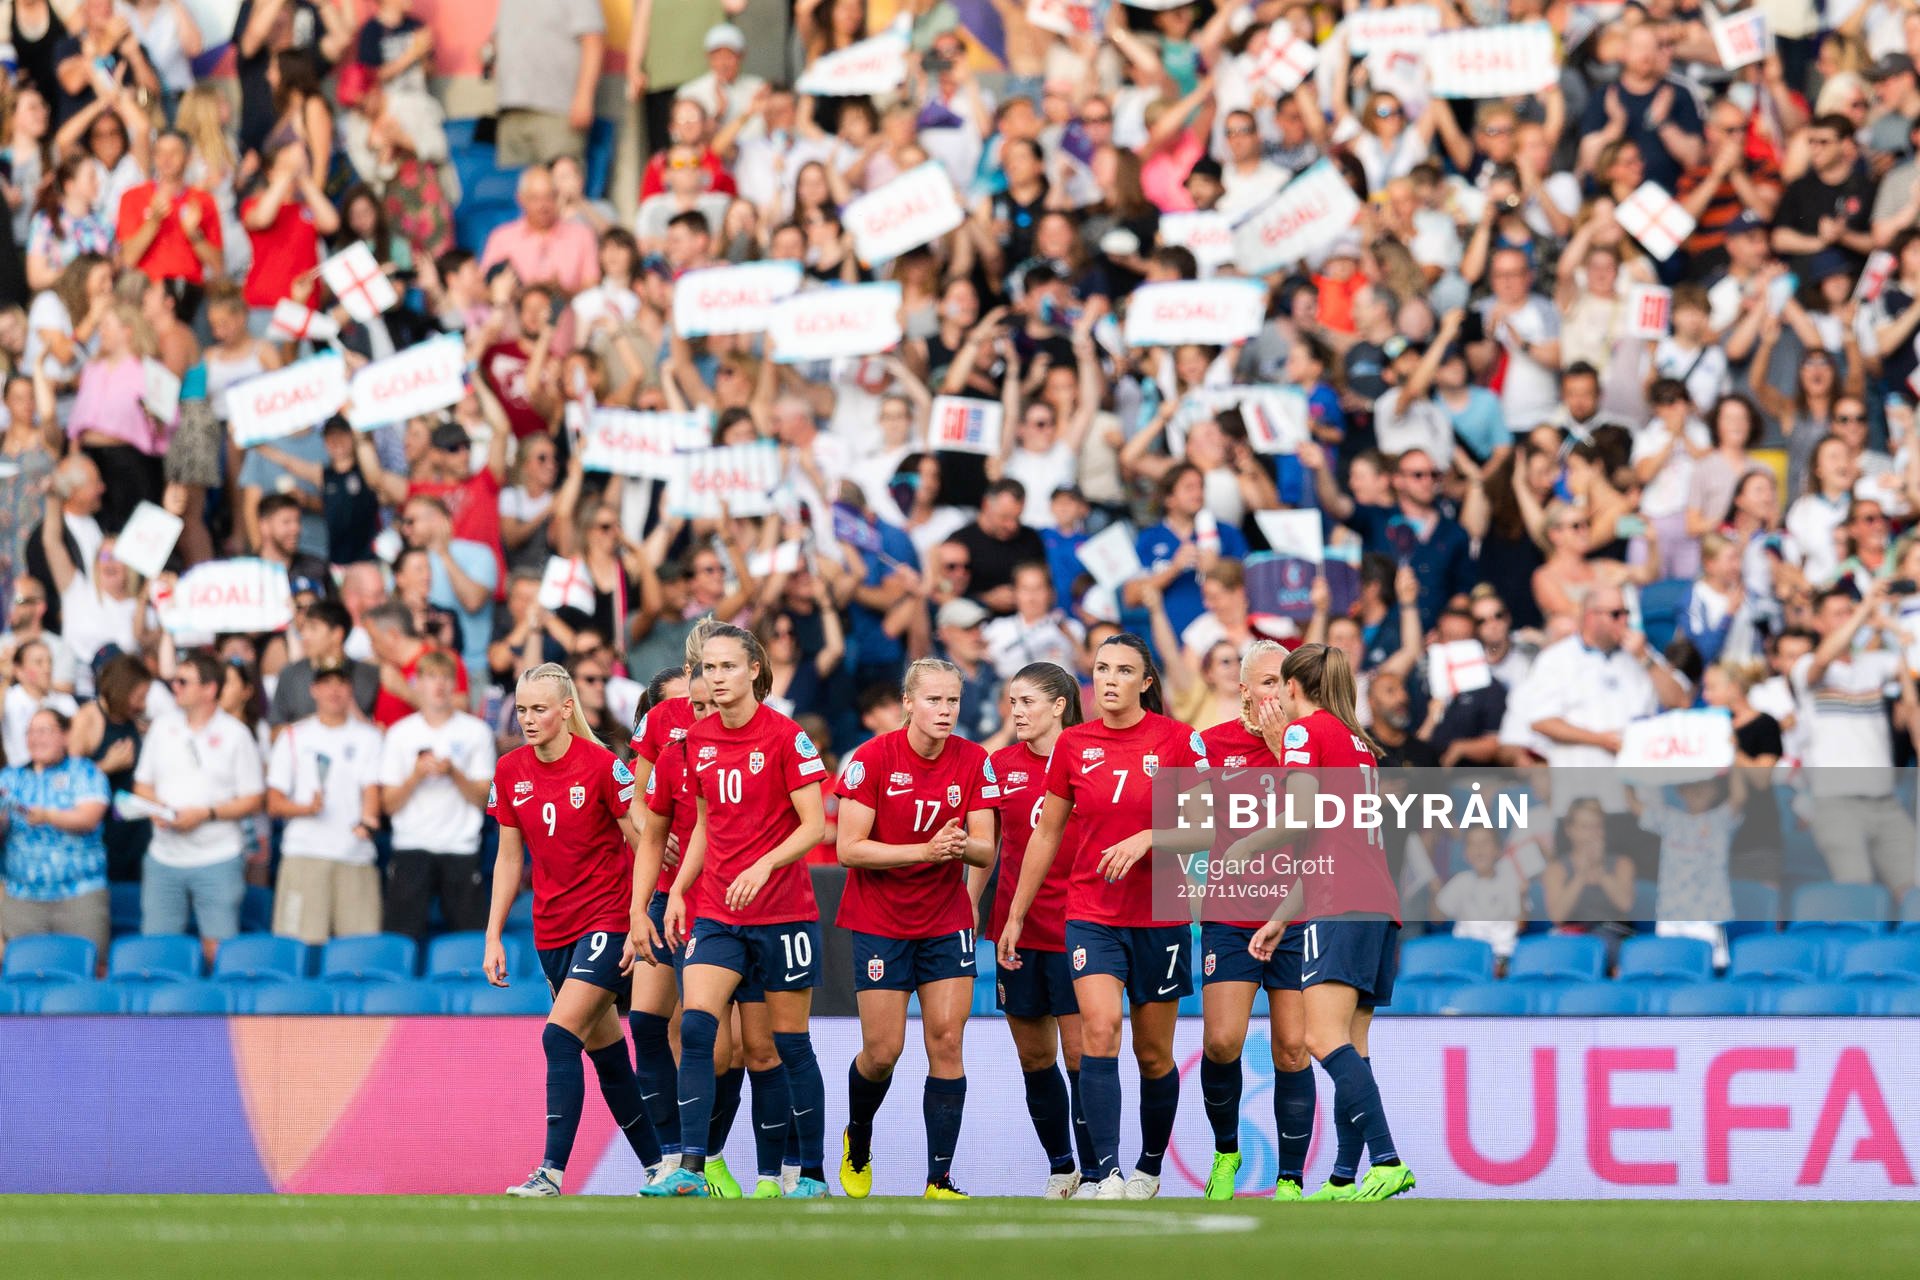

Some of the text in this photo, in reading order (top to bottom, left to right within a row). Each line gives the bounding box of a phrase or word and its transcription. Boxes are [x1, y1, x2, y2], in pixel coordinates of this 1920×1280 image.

[254, 377, 327, 417] GOAL!
[371, 364, 451, 401] GOAL!
[689, 464, 764, 496] GOAL!
[717, 768, 742, 804] 10
[1112, 769, 1129, 804] 7
[542, 802, 556, 837] 9
[914, 800, 941, 832] 17
[587, 932, 608, 962] 9
[780, 931, 812, 968] 10
[1303, 923, 1319, 962] 11
[1166, 943, 1180, 979] 7
[1443, 1046, 1917, 1186] UEFA
